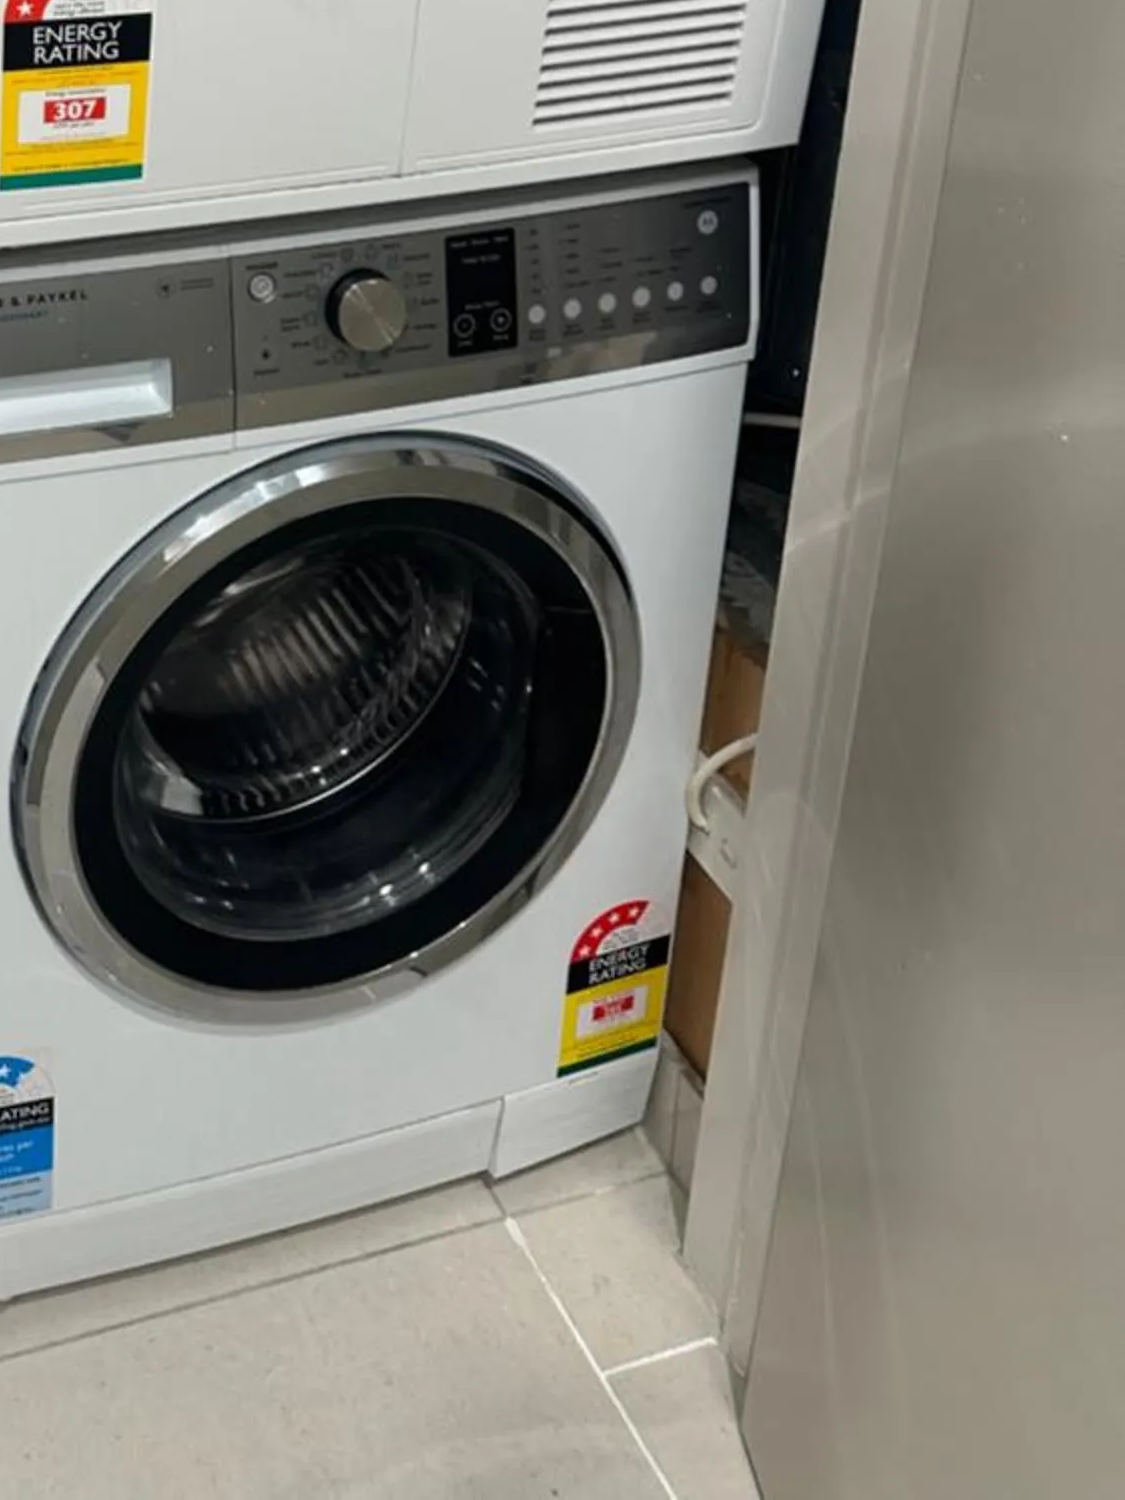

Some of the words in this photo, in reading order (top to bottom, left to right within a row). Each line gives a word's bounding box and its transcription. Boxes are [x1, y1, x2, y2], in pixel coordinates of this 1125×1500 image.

[32, 20, 123, 45] ENERGY
[33, 40, 120, 65] RATING
[53, 99, 98, 121] 307
[10, 296, 20, 306] &
[26, 289, 88, 305] PAYKEL
[589, 944, 651, 972] ENERGY
[588, 959, 647, 985] RATING
